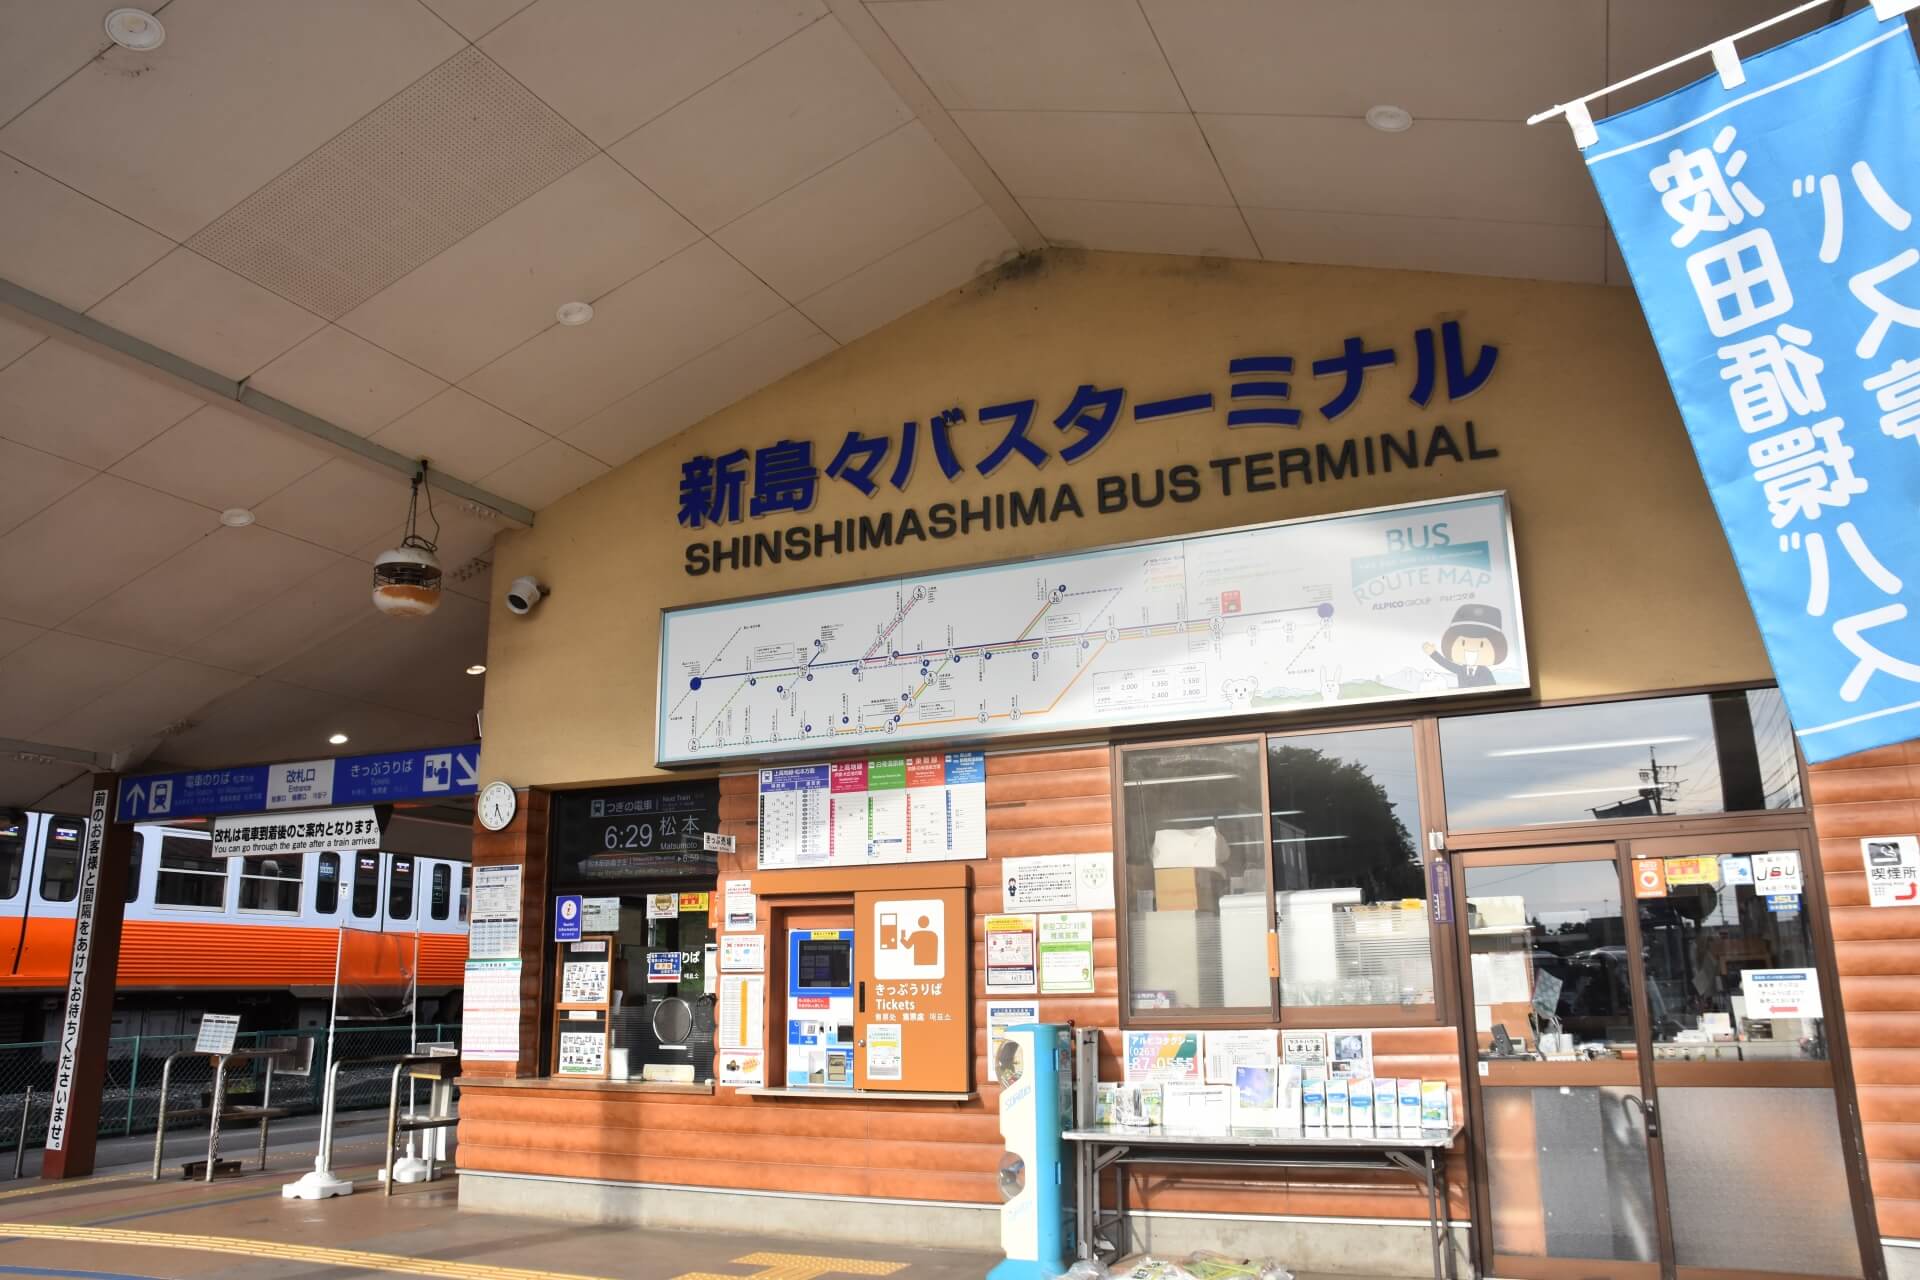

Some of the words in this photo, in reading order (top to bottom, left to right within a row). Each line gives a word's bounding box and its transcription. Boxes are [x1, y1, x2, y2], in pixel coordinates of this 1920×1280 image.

[677, 321, 1499, 528] 新島々バスターミナル
[684, 482, 1084, 577] SHINSHIMASHIMA
[1097, 464, 1202, 514] BUS
[1209, 420, 1499, 497] TERMINAL
[1385, 522, 1452, 553] BUS
[1353, 566, 1430, 605] ROUTE
[1437, 567, 1492, 589] MAP
[286, 768, 316, 783] 改札口
[351, 759, 414, 777] きっぷうりば
[185, 772, 230, 787] 電車のりば
[288, 784, 312, 793] Entrance
[606, 800, 653, 813] つぎの電車
[214, 819, 379, 843] 改札は電車到着後のご案内となります。
[658, 815, 700, 836] 松本
[604, 823, 653, 849] 6:29
[706, 834, 732, 846] きっぷ売場
[214, 844, 228, 854] You
[228, 845, 241, 853] can
[242, 845, 251, 854] go
[252, 842, 278, 852] through
[279, 842, 291, 850] the
[292, 840, 308, 851] gate
[309, 839, 325, 848] after
[333, 837, 350, 847] train
[660, 841, 698, 850] Matsumoto
[1757, 864, 1796, 881] JSU
[1871, 866, 1917, 880] 喫煙所
[51, 792, 106, 1148] 前のお客様と間隔をあけてお待ちくださいませ。
[875, 983, 943, 996] きっぷうりば
[875, 999, 916, 1010] Tickets
[1287, 1044, 1321, 1052] しましま
